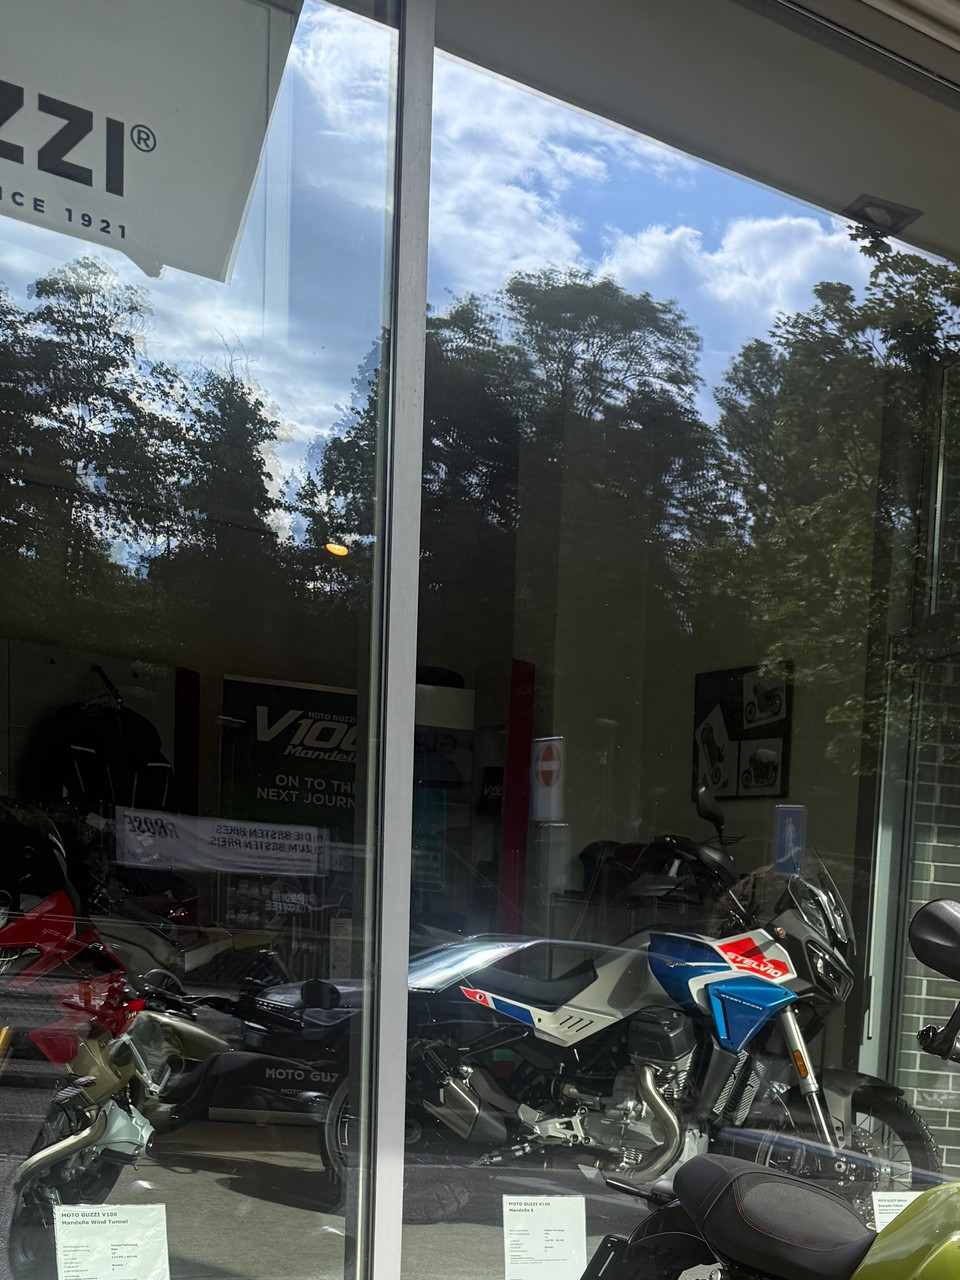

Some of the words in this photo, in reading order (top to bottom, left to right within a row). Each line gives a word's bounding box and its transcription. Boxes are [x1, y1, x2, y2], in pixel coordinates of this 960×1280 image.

[0, 186, 46, 214] CE
[65, 207, 126, 239] 1921
[275, 774, 299, 788] ON
[304, 776, 327, 791] TO
[256, 786, 299, 803] NEXT
[725, 951, 782, 978] STELVIO
[265, 1067, 305, 1080] MOTO
